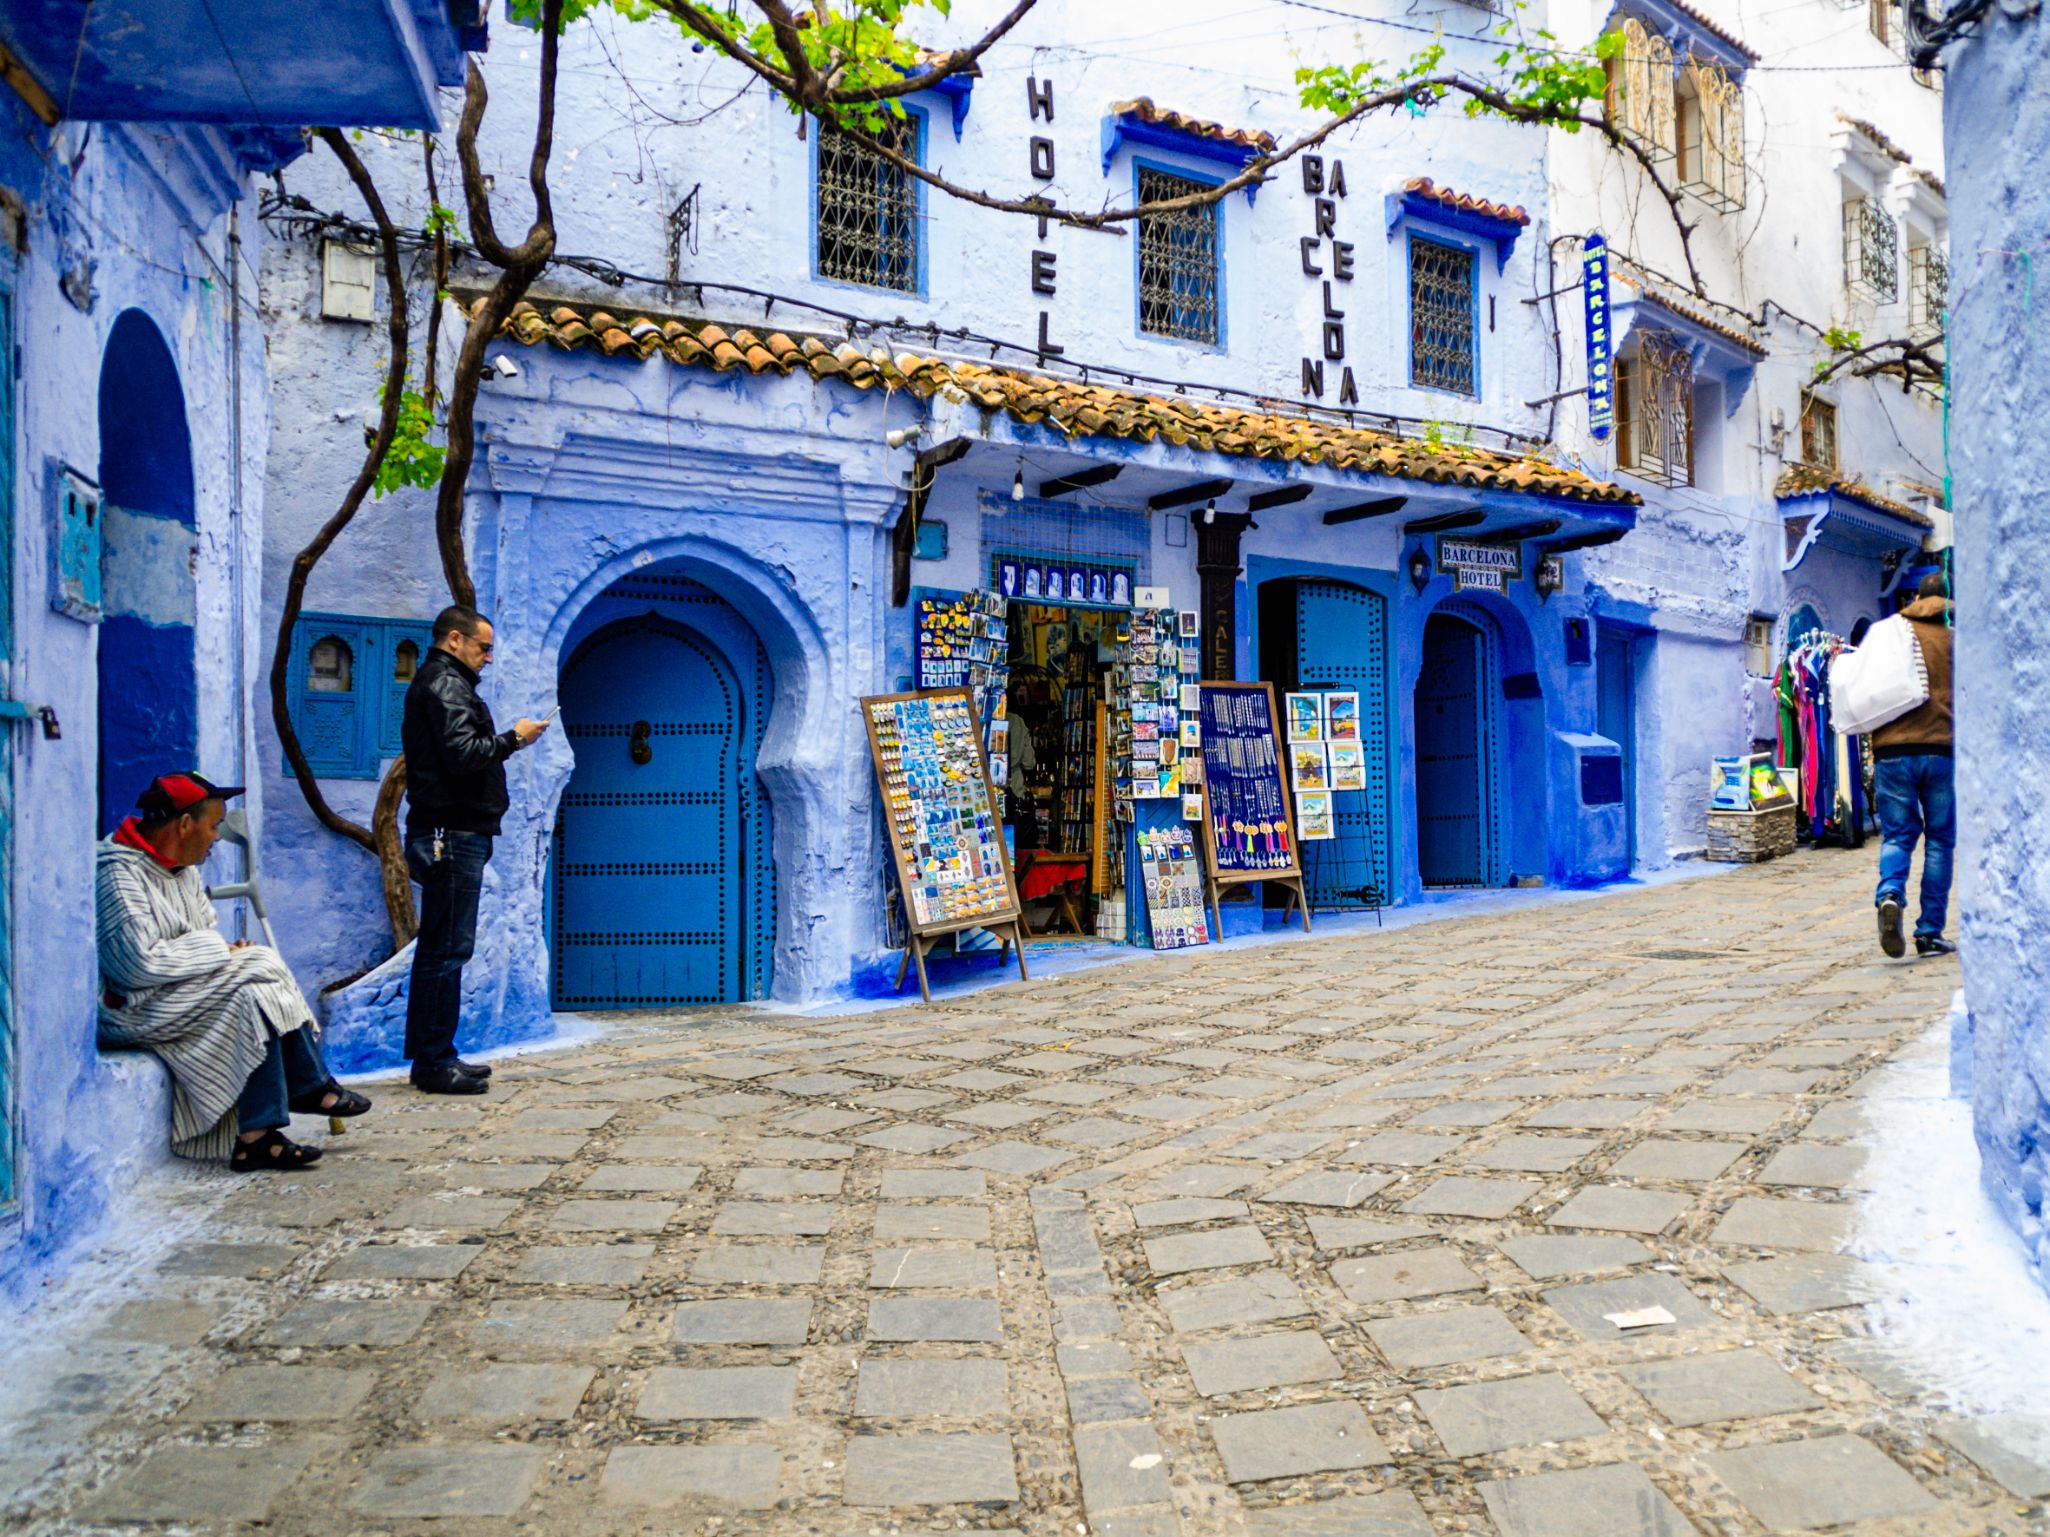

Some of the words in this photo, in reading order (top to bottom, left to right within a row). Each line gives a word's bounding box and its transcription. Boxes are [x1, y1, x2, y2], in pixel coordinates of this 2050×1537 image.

[1026, 76, 1064, 354] HOTEL
[1583, 244, 1606, 262] HOTEL
[1300, 154, 1359, 404] BARCELONA
[1590, 261, 1609, 411] BARCELONA
[1443, 546, 1516, 567] BARCELONA
[1461, 570, 1501, 587] HOTEL
